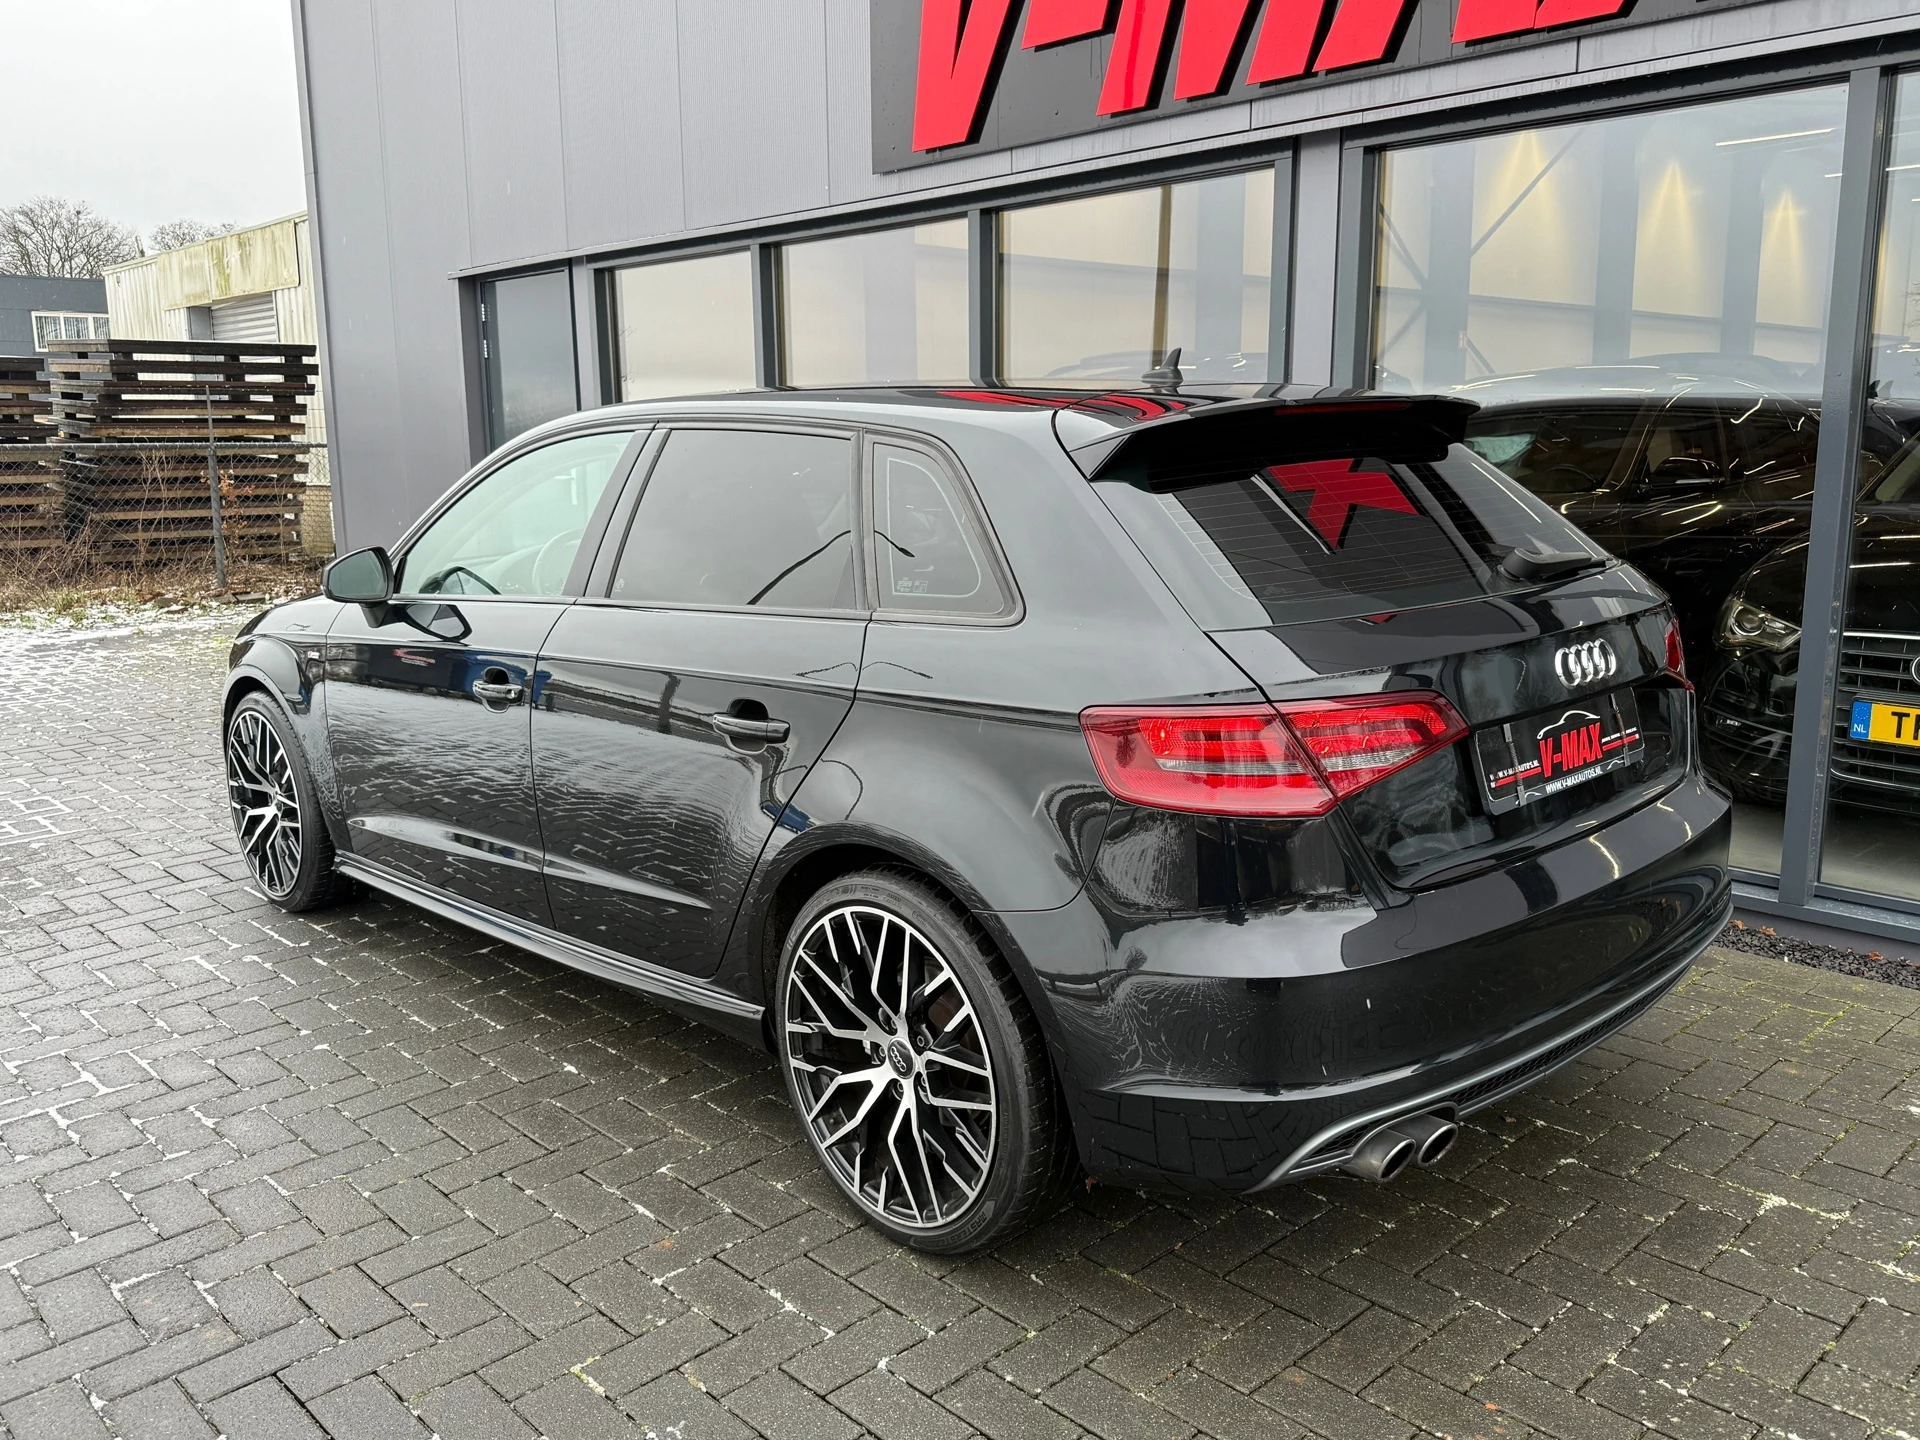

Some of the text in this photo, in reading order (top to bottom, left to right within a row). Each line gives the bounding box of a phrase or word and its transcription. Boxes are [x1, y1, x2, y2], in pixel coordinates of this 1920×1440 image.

[1853, 723, 1867, 733] NL
[1539, 722, 1603, 778] V-MAX
[1545, 765, 1603, 794] WWW.V-MAXAUTOS.NL
